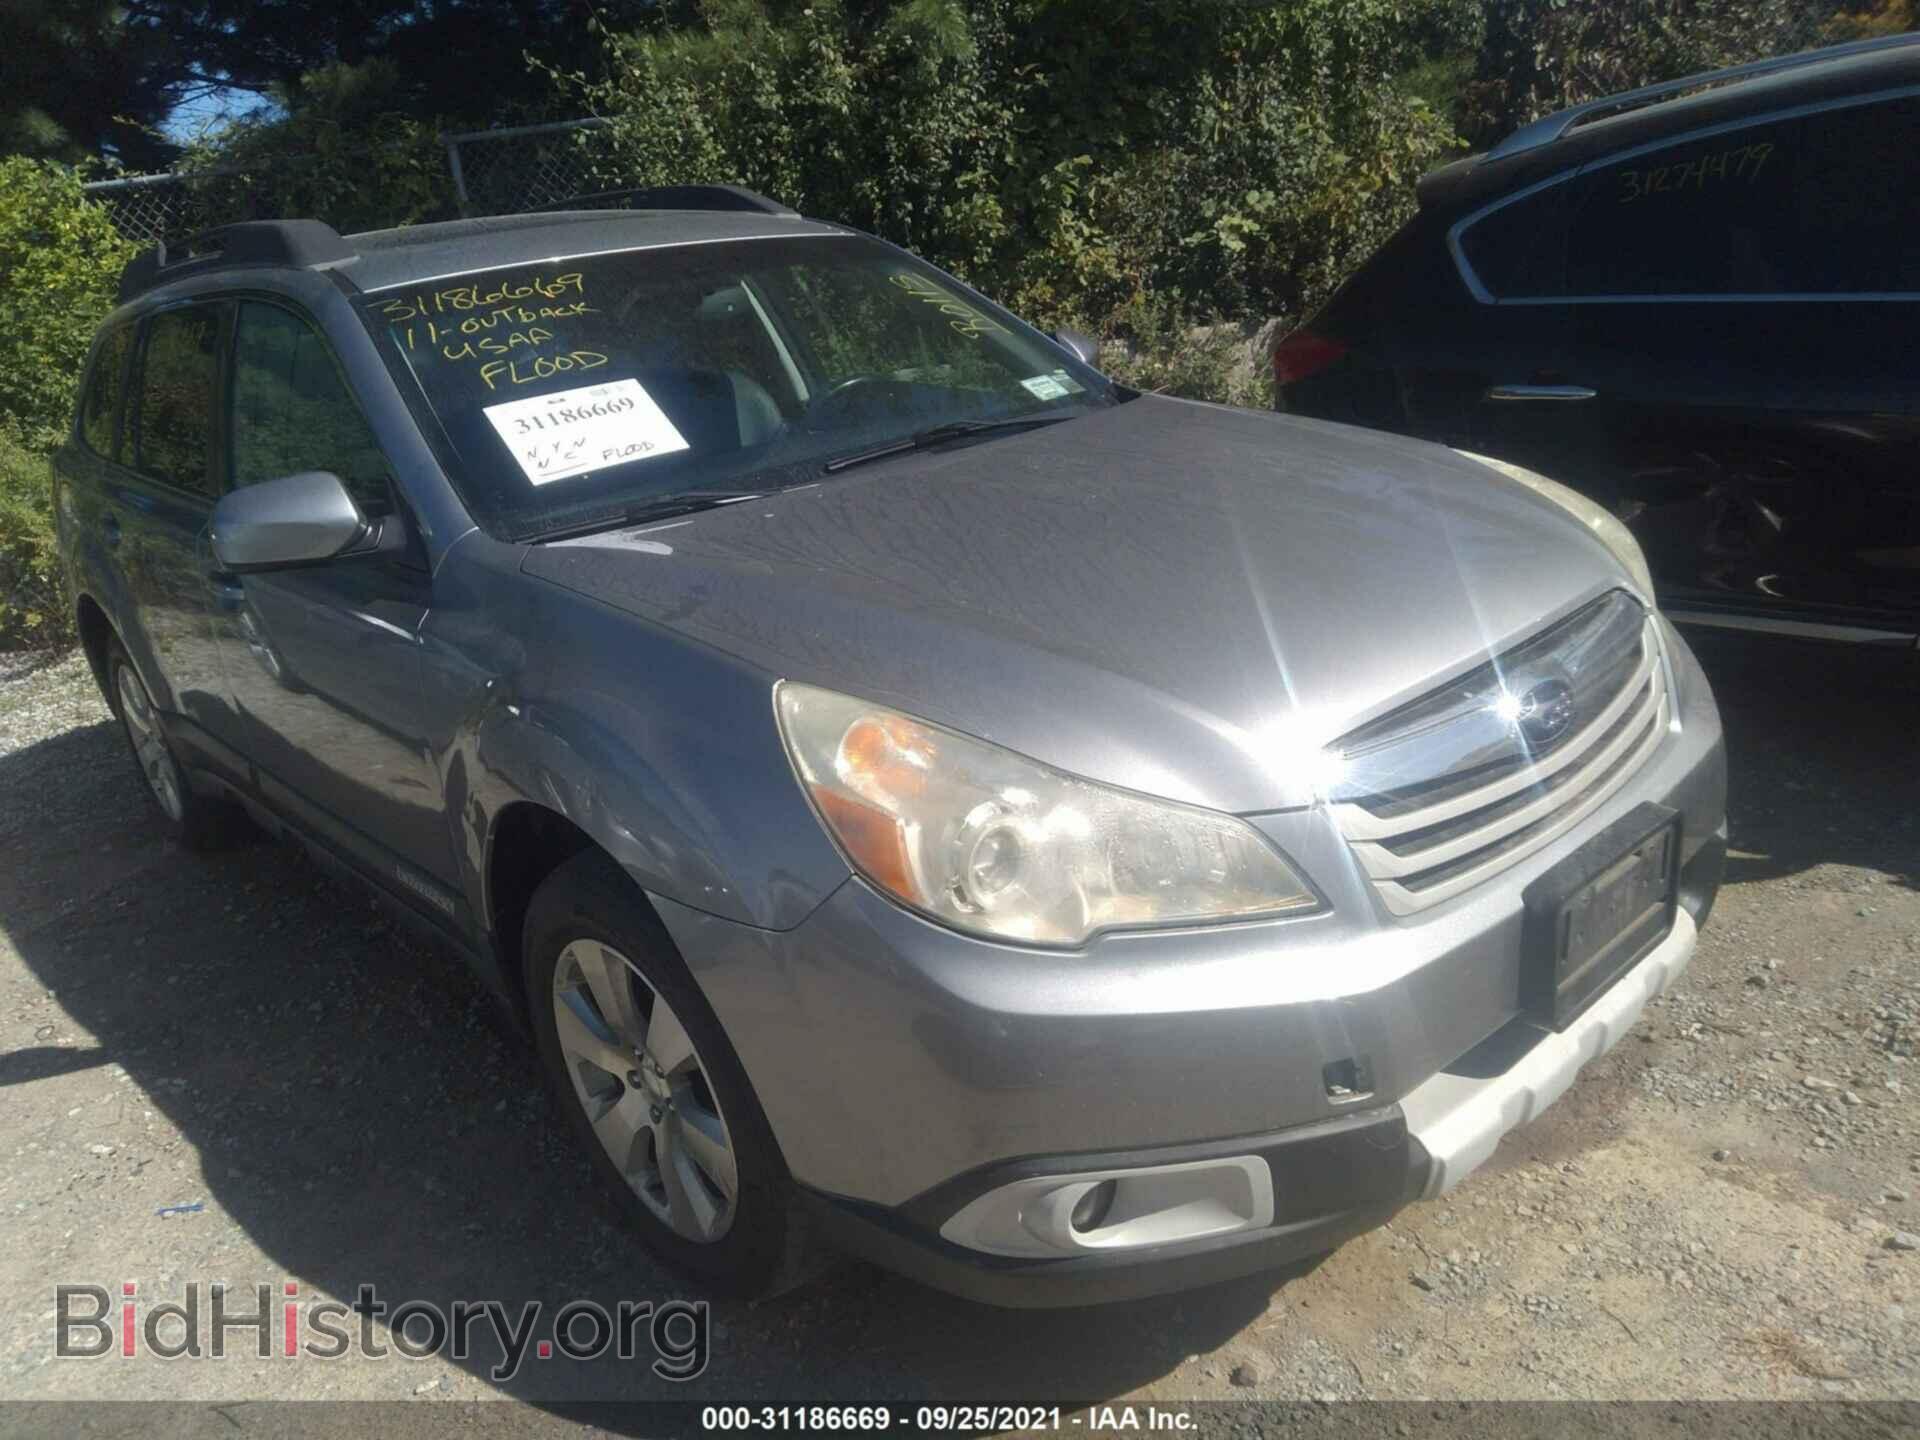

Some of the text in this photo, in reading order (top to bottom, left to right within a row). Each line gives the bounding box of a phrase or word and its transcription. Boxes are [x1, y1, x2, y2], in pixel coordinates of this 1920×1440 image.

[373, 273, 583, 322] 31186669
[480, 351, 608, 390] FLOOD
[514, 397, 634, 434] 31186669
[602, 441, 654, 461] FLOOD
